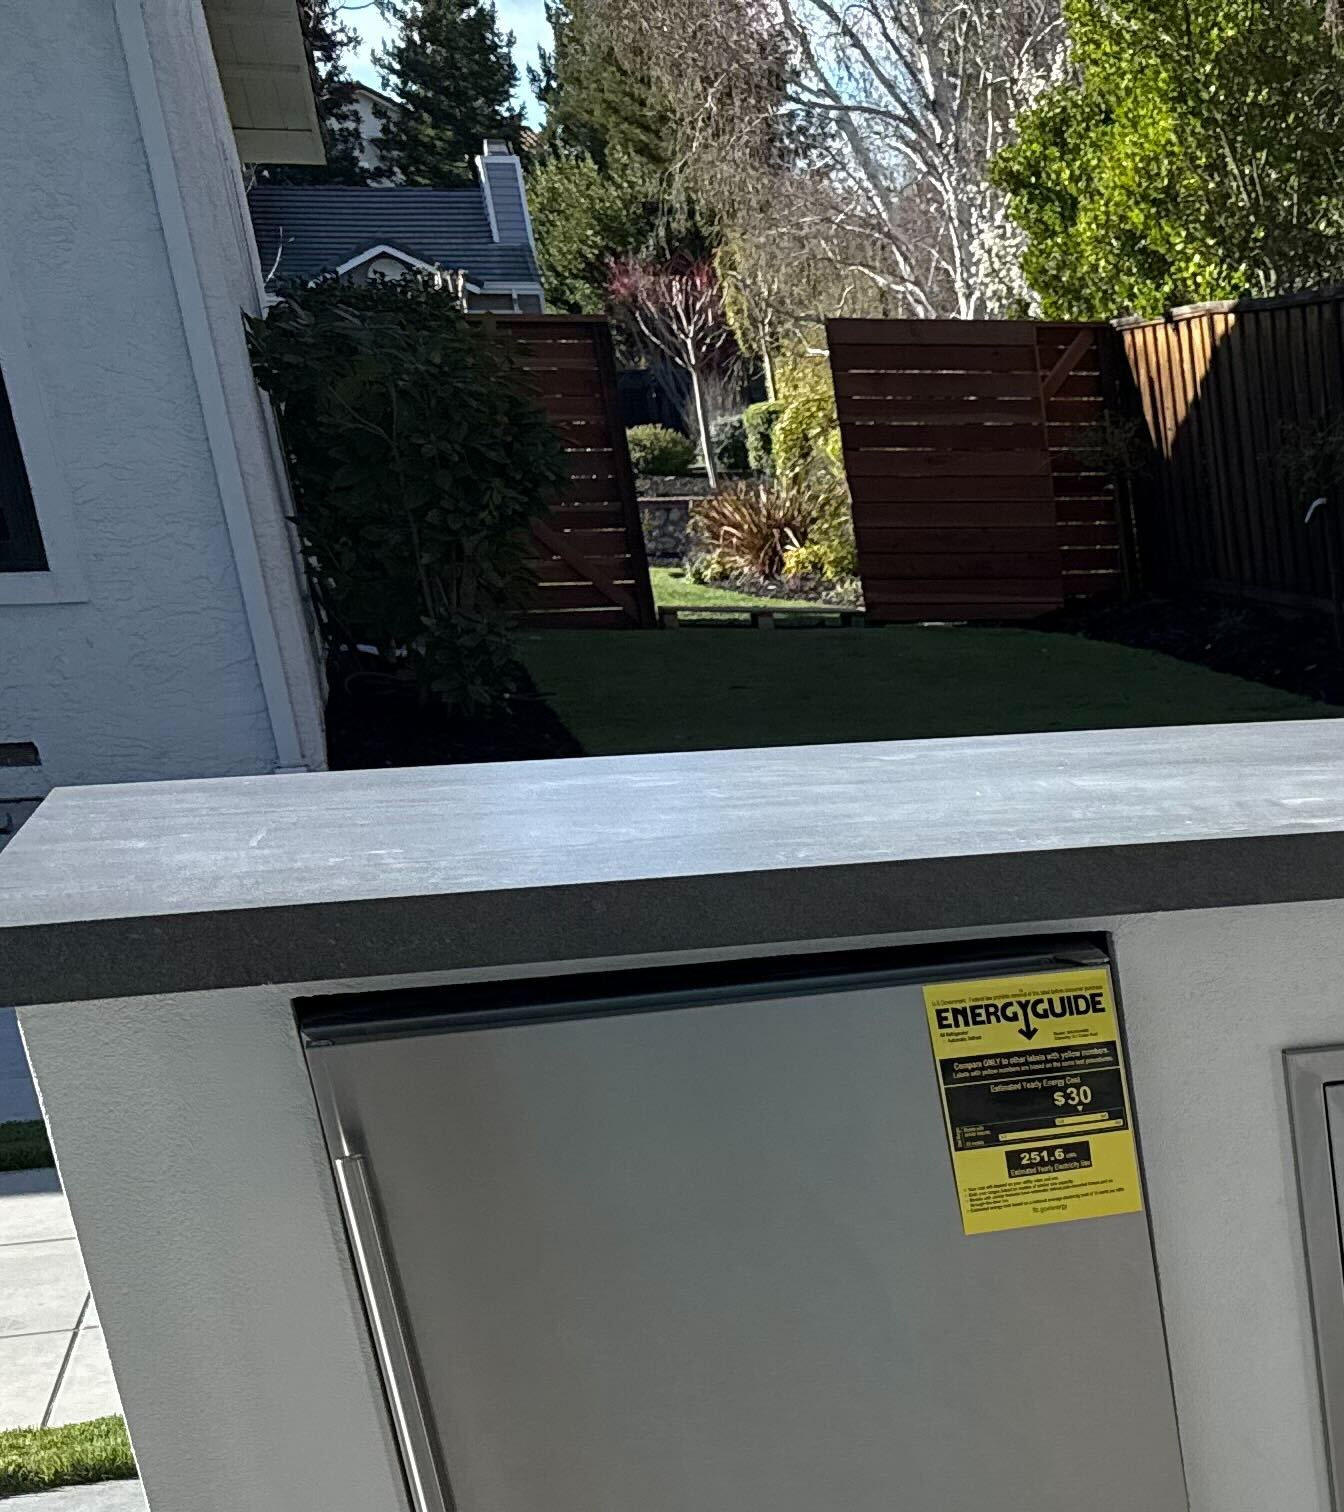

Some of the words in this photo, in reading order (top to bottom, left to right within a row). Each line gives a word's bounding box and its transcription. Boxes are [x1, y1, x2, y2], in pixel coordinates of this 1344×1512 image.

[935, 992, 1106, 1031] ENERGYGUIDE
[1053, 1086, 1092, 1106] $30
[1020, 1148, 1065, 1165] 251.6
